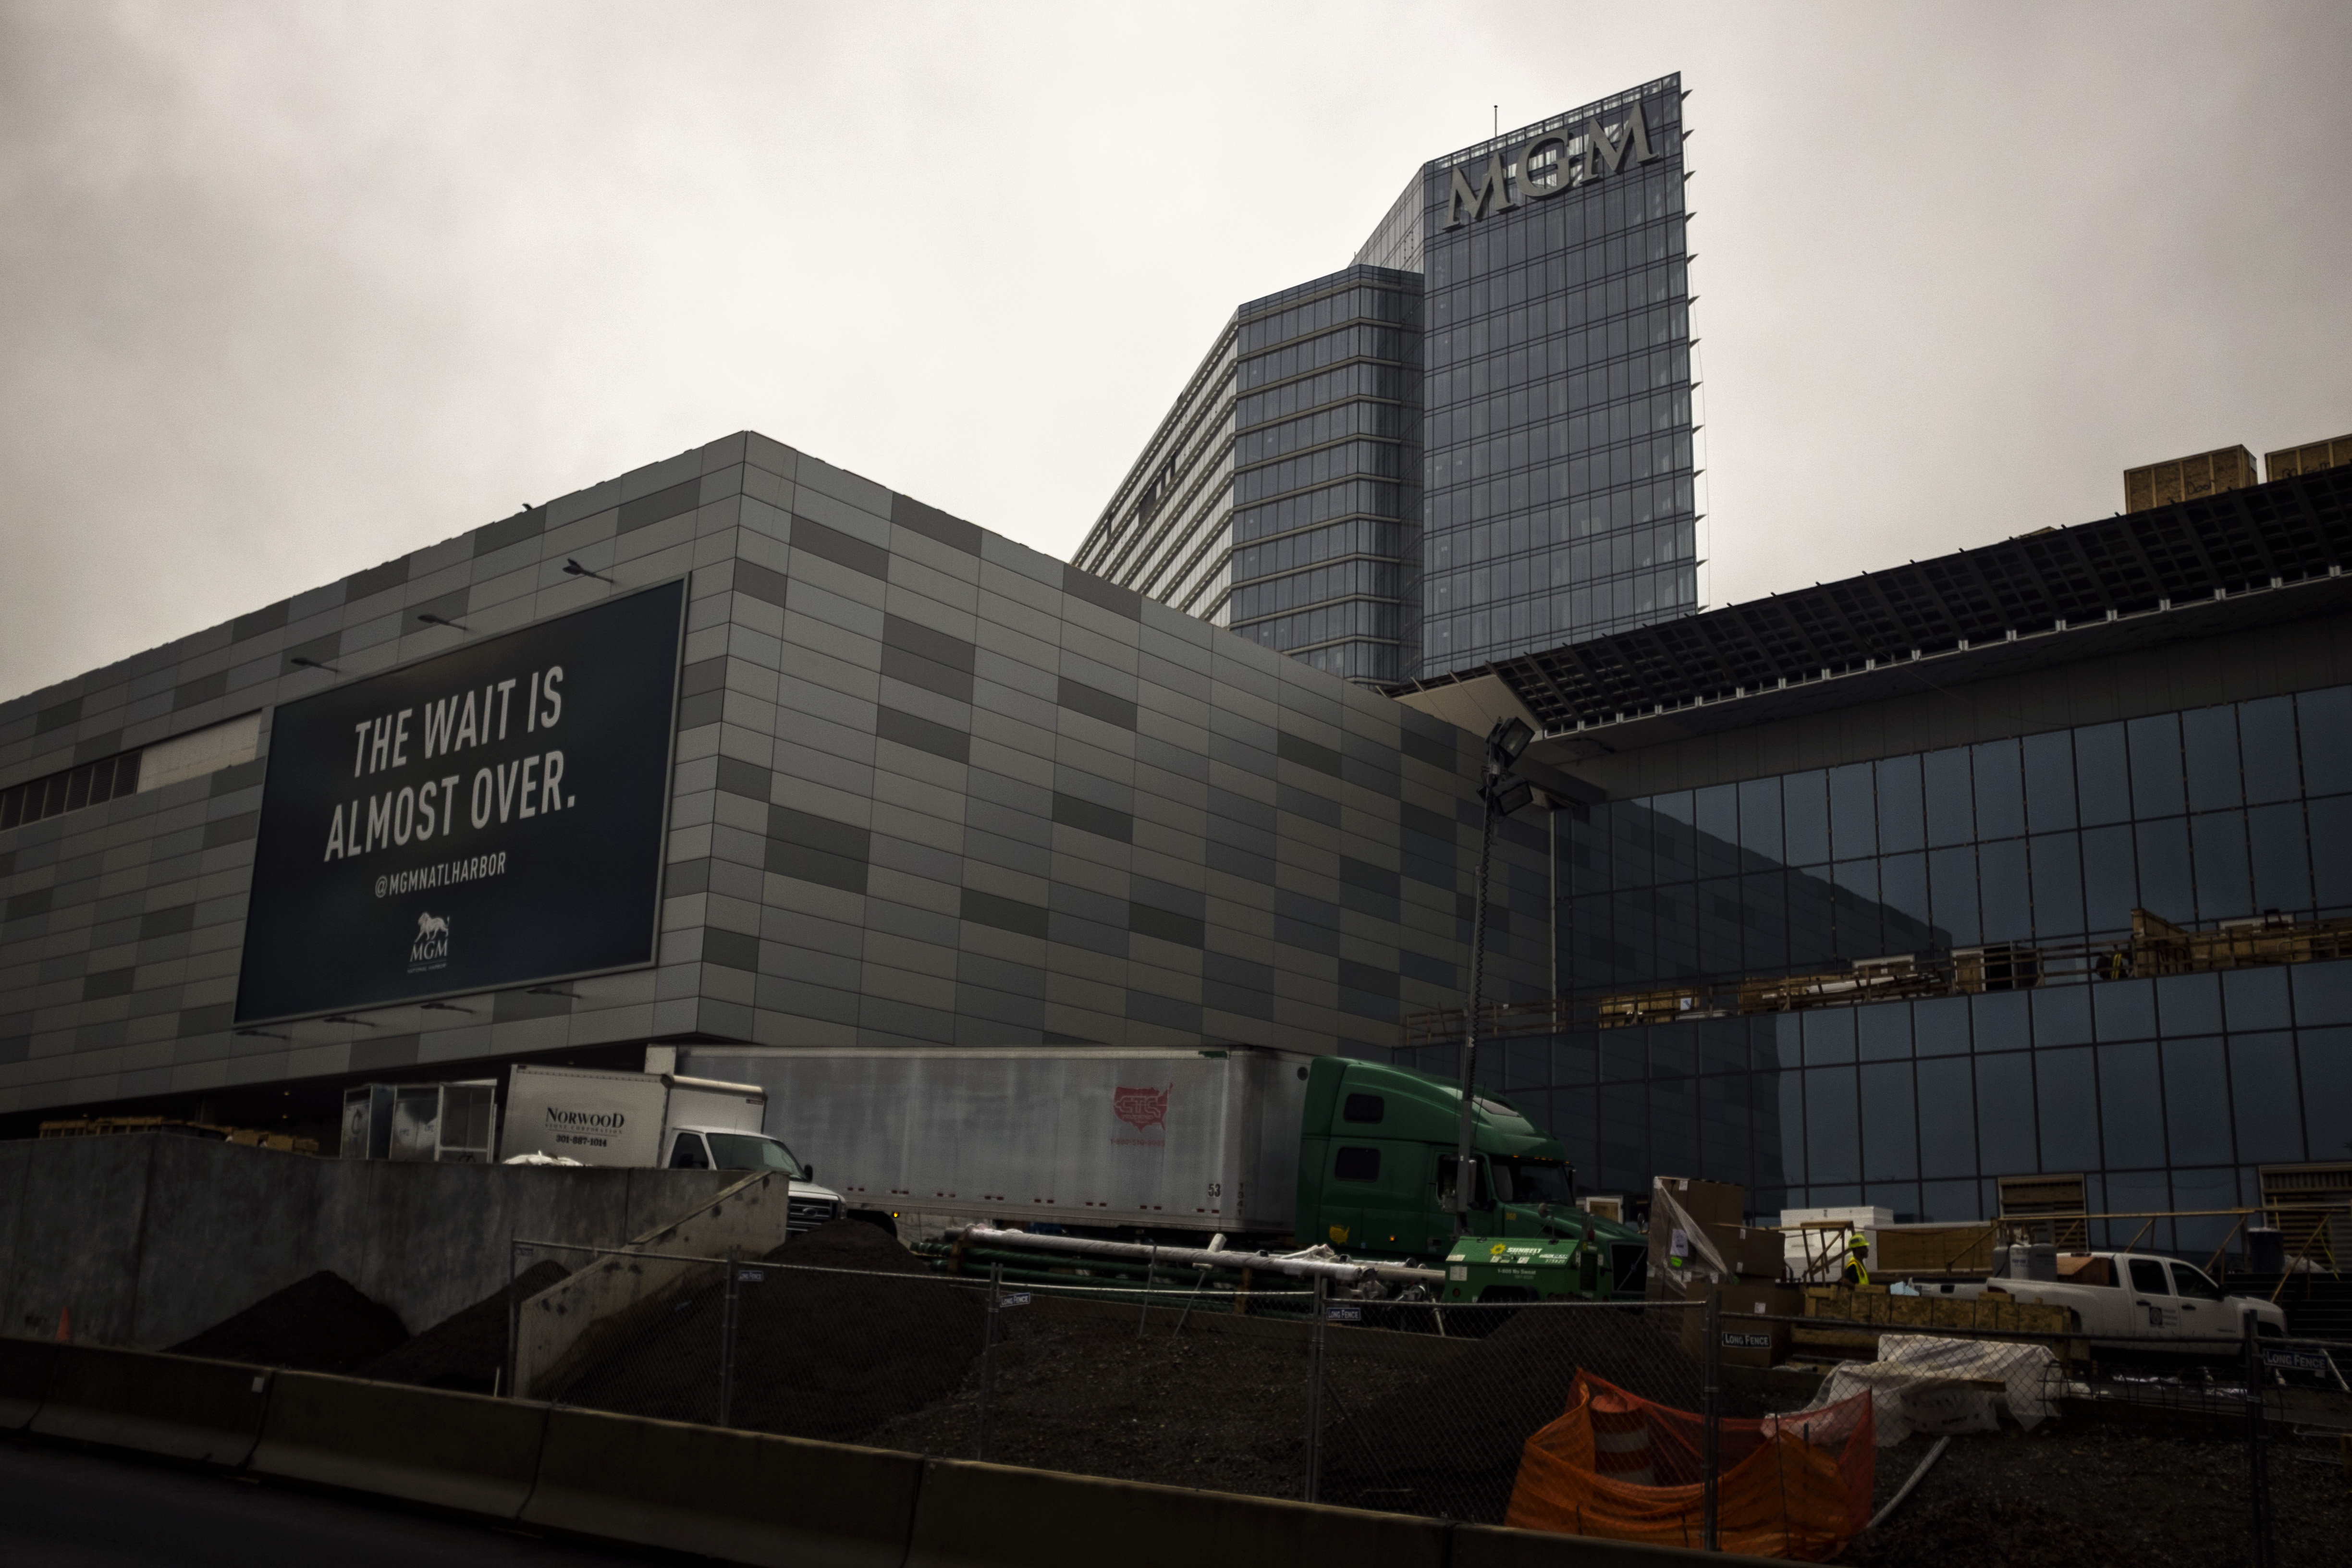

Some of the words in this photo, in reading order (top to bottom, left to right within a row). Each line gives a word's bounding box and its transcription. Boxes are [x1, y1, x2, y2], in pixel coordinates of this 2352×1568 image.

[1442, 100, 1660, 230] MGM
[355, 708, 413, 778] THE
[425, 678, 516, 760] WAIT
[527, 665, 564, 733] IS
[324, 774, 459, 862] ALMOST
[471, 749, 576, 830] OVER.
[375, 851, 506, 898] @MGMNATLHARBOR
[410, 938, 448, 962] MGM
[546, 1107, 624, 1128] NORWOOD
[1209, 1183, 1220, 1197] 53
[1014, 1296, 1028, 1304] FENCE
[1328, 1309, 1340, 1319] LONG
[1341, 1309, 1359, 1319] FENCE
[1725, 1334, 1743, 1345] LONG
[1745, 1335, 1768, 1346] FENCE
[2267, 1350, 2292, 1365] LONG
[2294, 1354, 2326, 1369] FENCE
